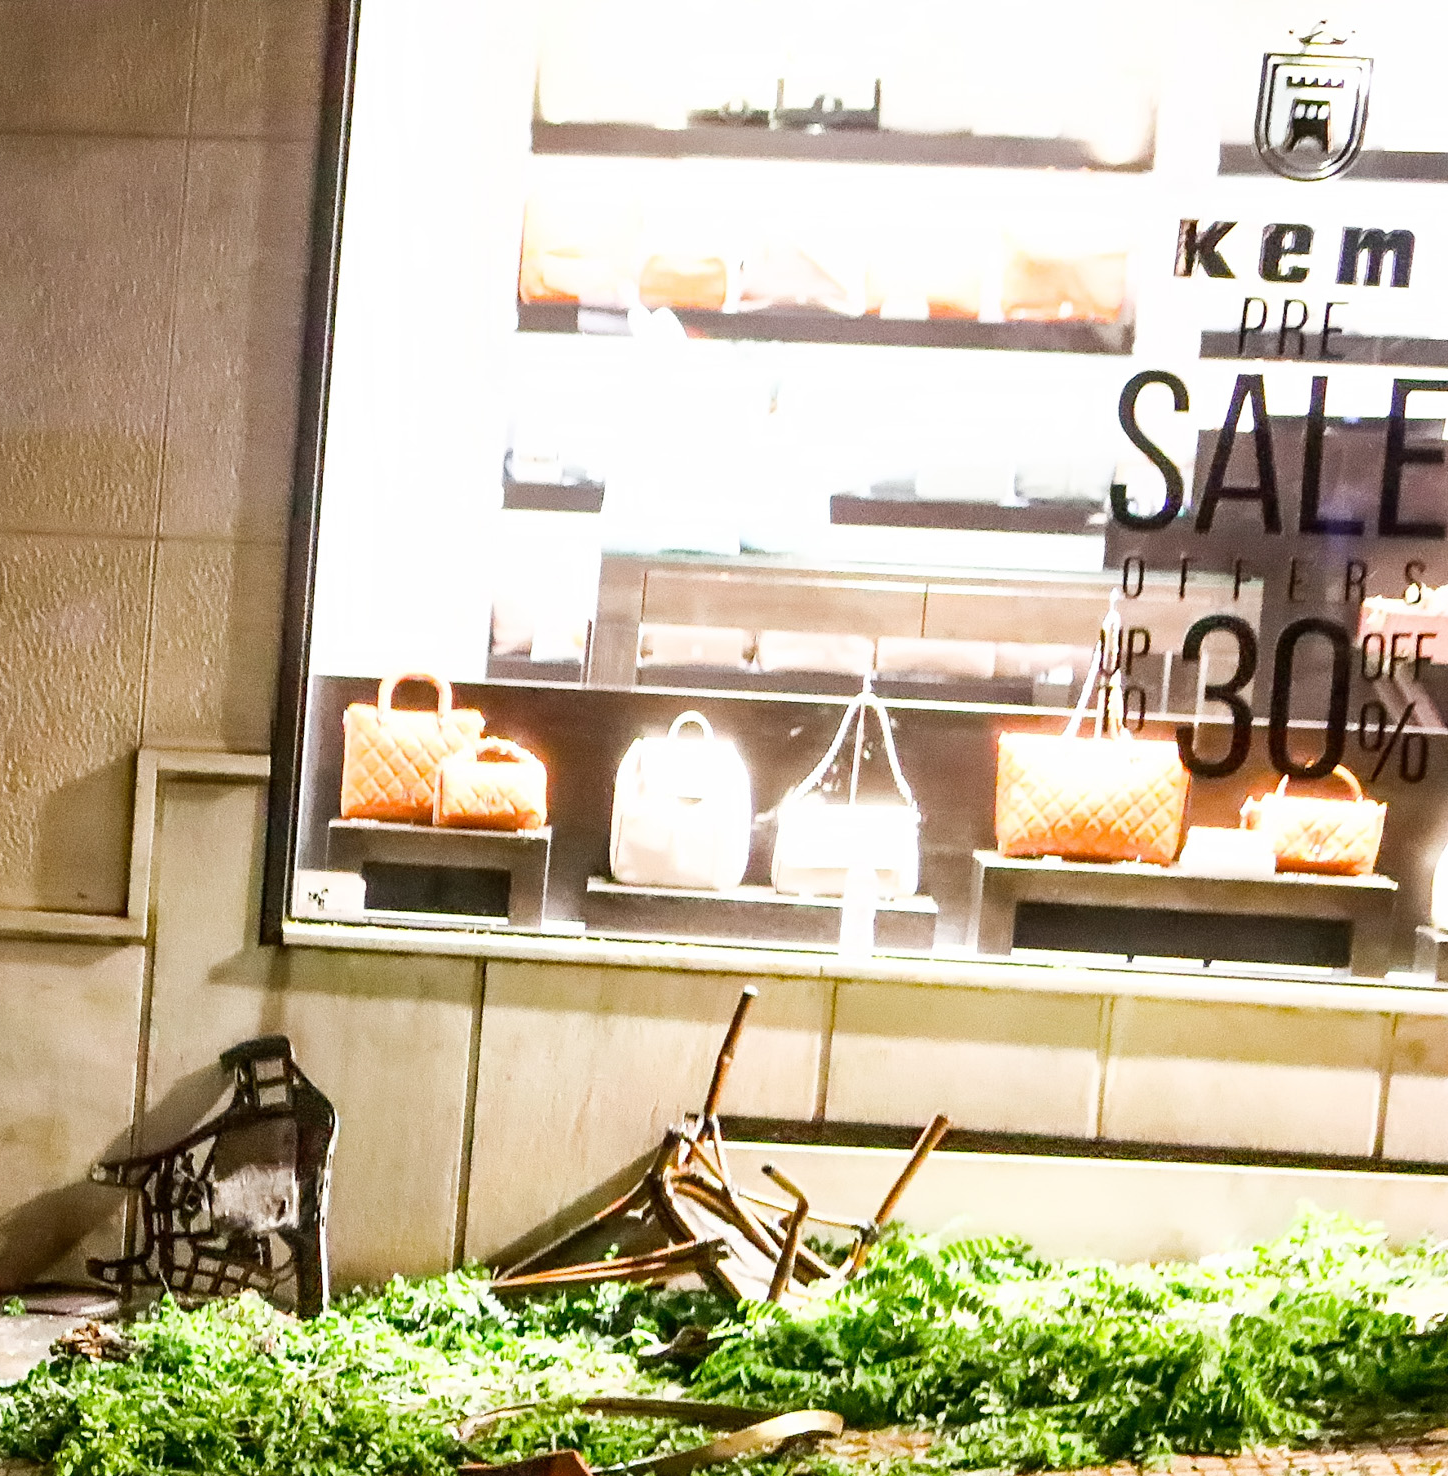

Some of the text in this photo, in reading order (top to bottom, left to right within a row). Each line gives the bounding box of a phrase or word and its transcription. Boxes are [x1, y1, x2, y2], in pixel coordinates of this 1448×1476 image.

[1237, 297, 1350, 360] PRE
[1109, 369, 1448, 540] SALE
[1176, 615, 1353, 779] 30
[1361, 631, 1437, 683] OFF
[1358, 700, 1430, 784] %
